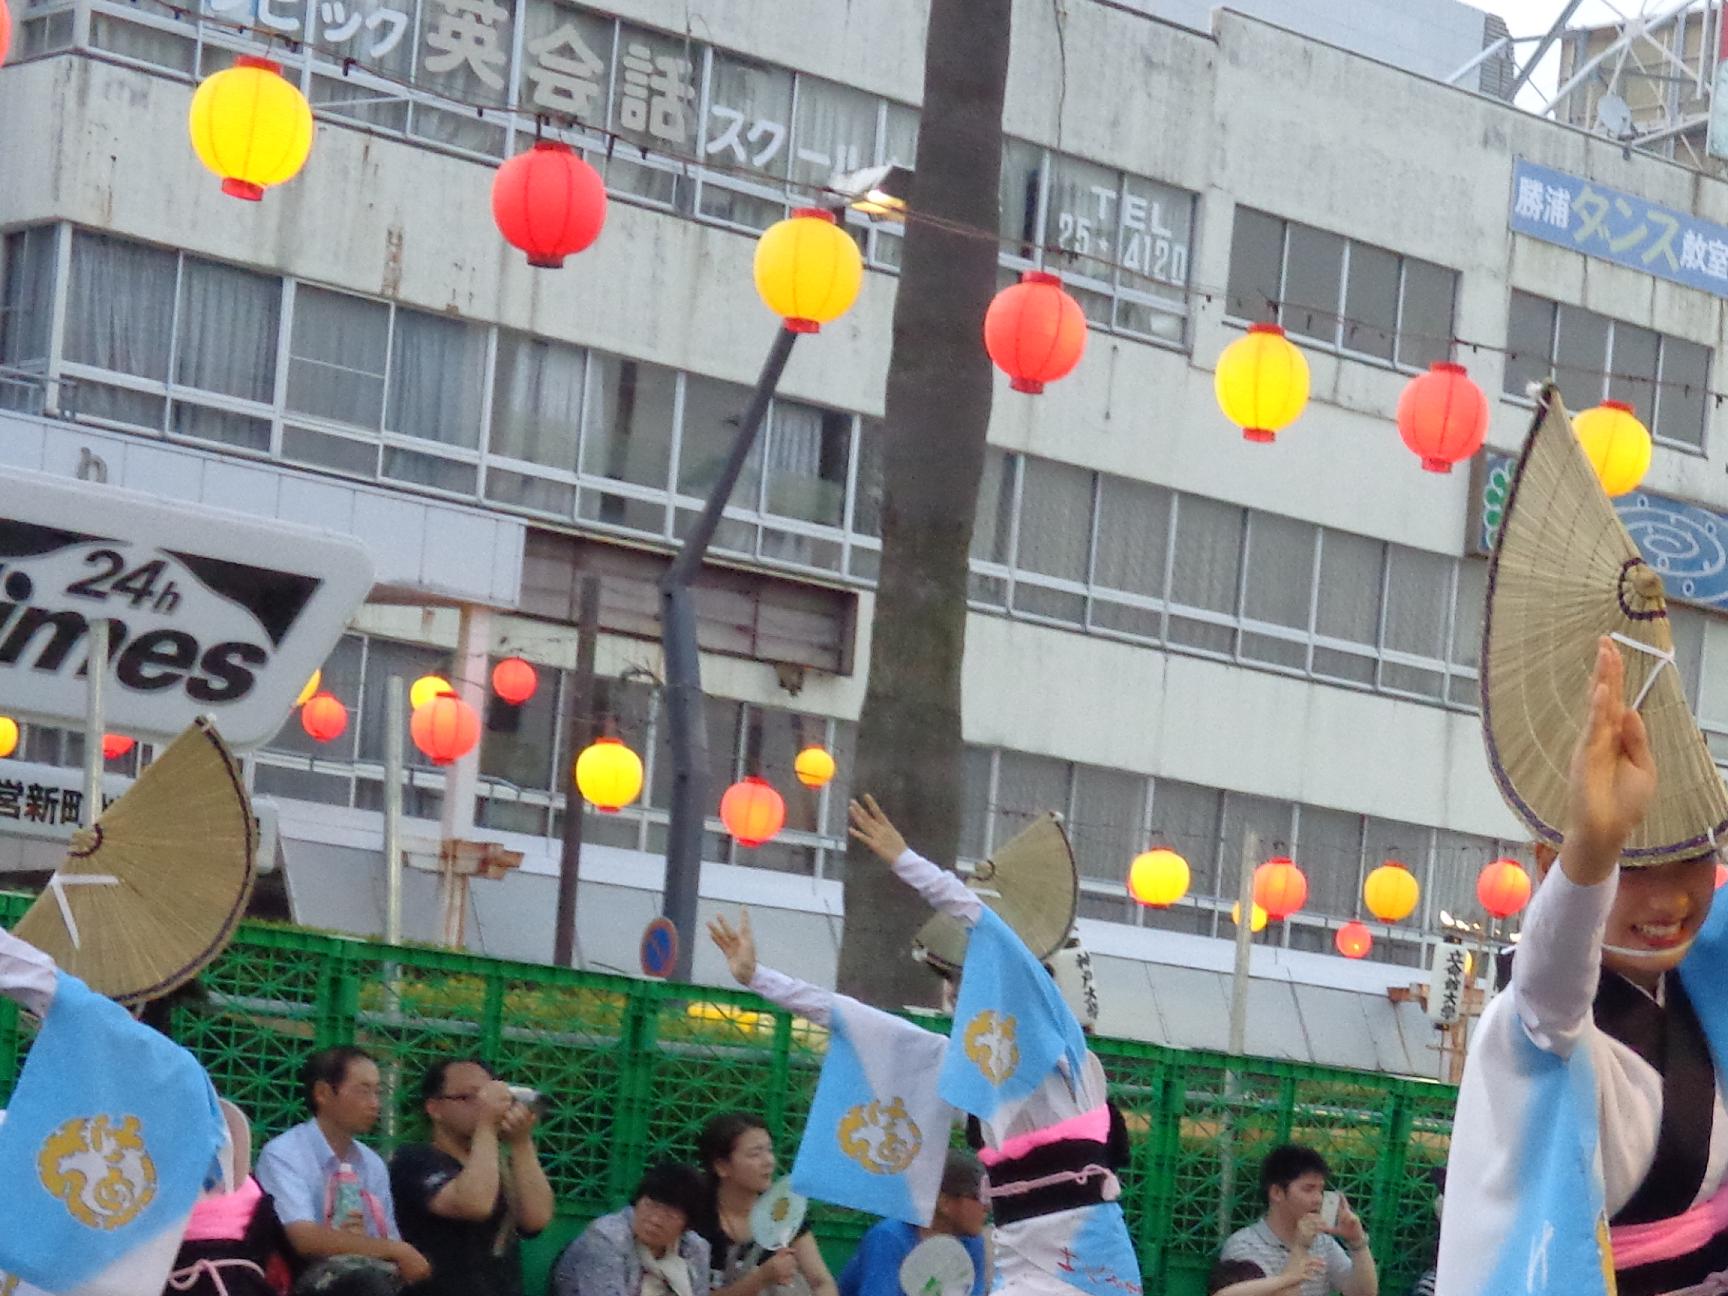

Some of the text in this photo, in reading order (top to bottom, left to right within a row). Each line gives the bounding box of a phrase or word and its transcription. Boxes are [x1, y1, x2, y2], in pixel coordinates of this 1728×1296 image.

[1091, 185, 1172, 238] TEL
[67, 549, 182, 617] 24h
[0, 564, 268, 703] imes
